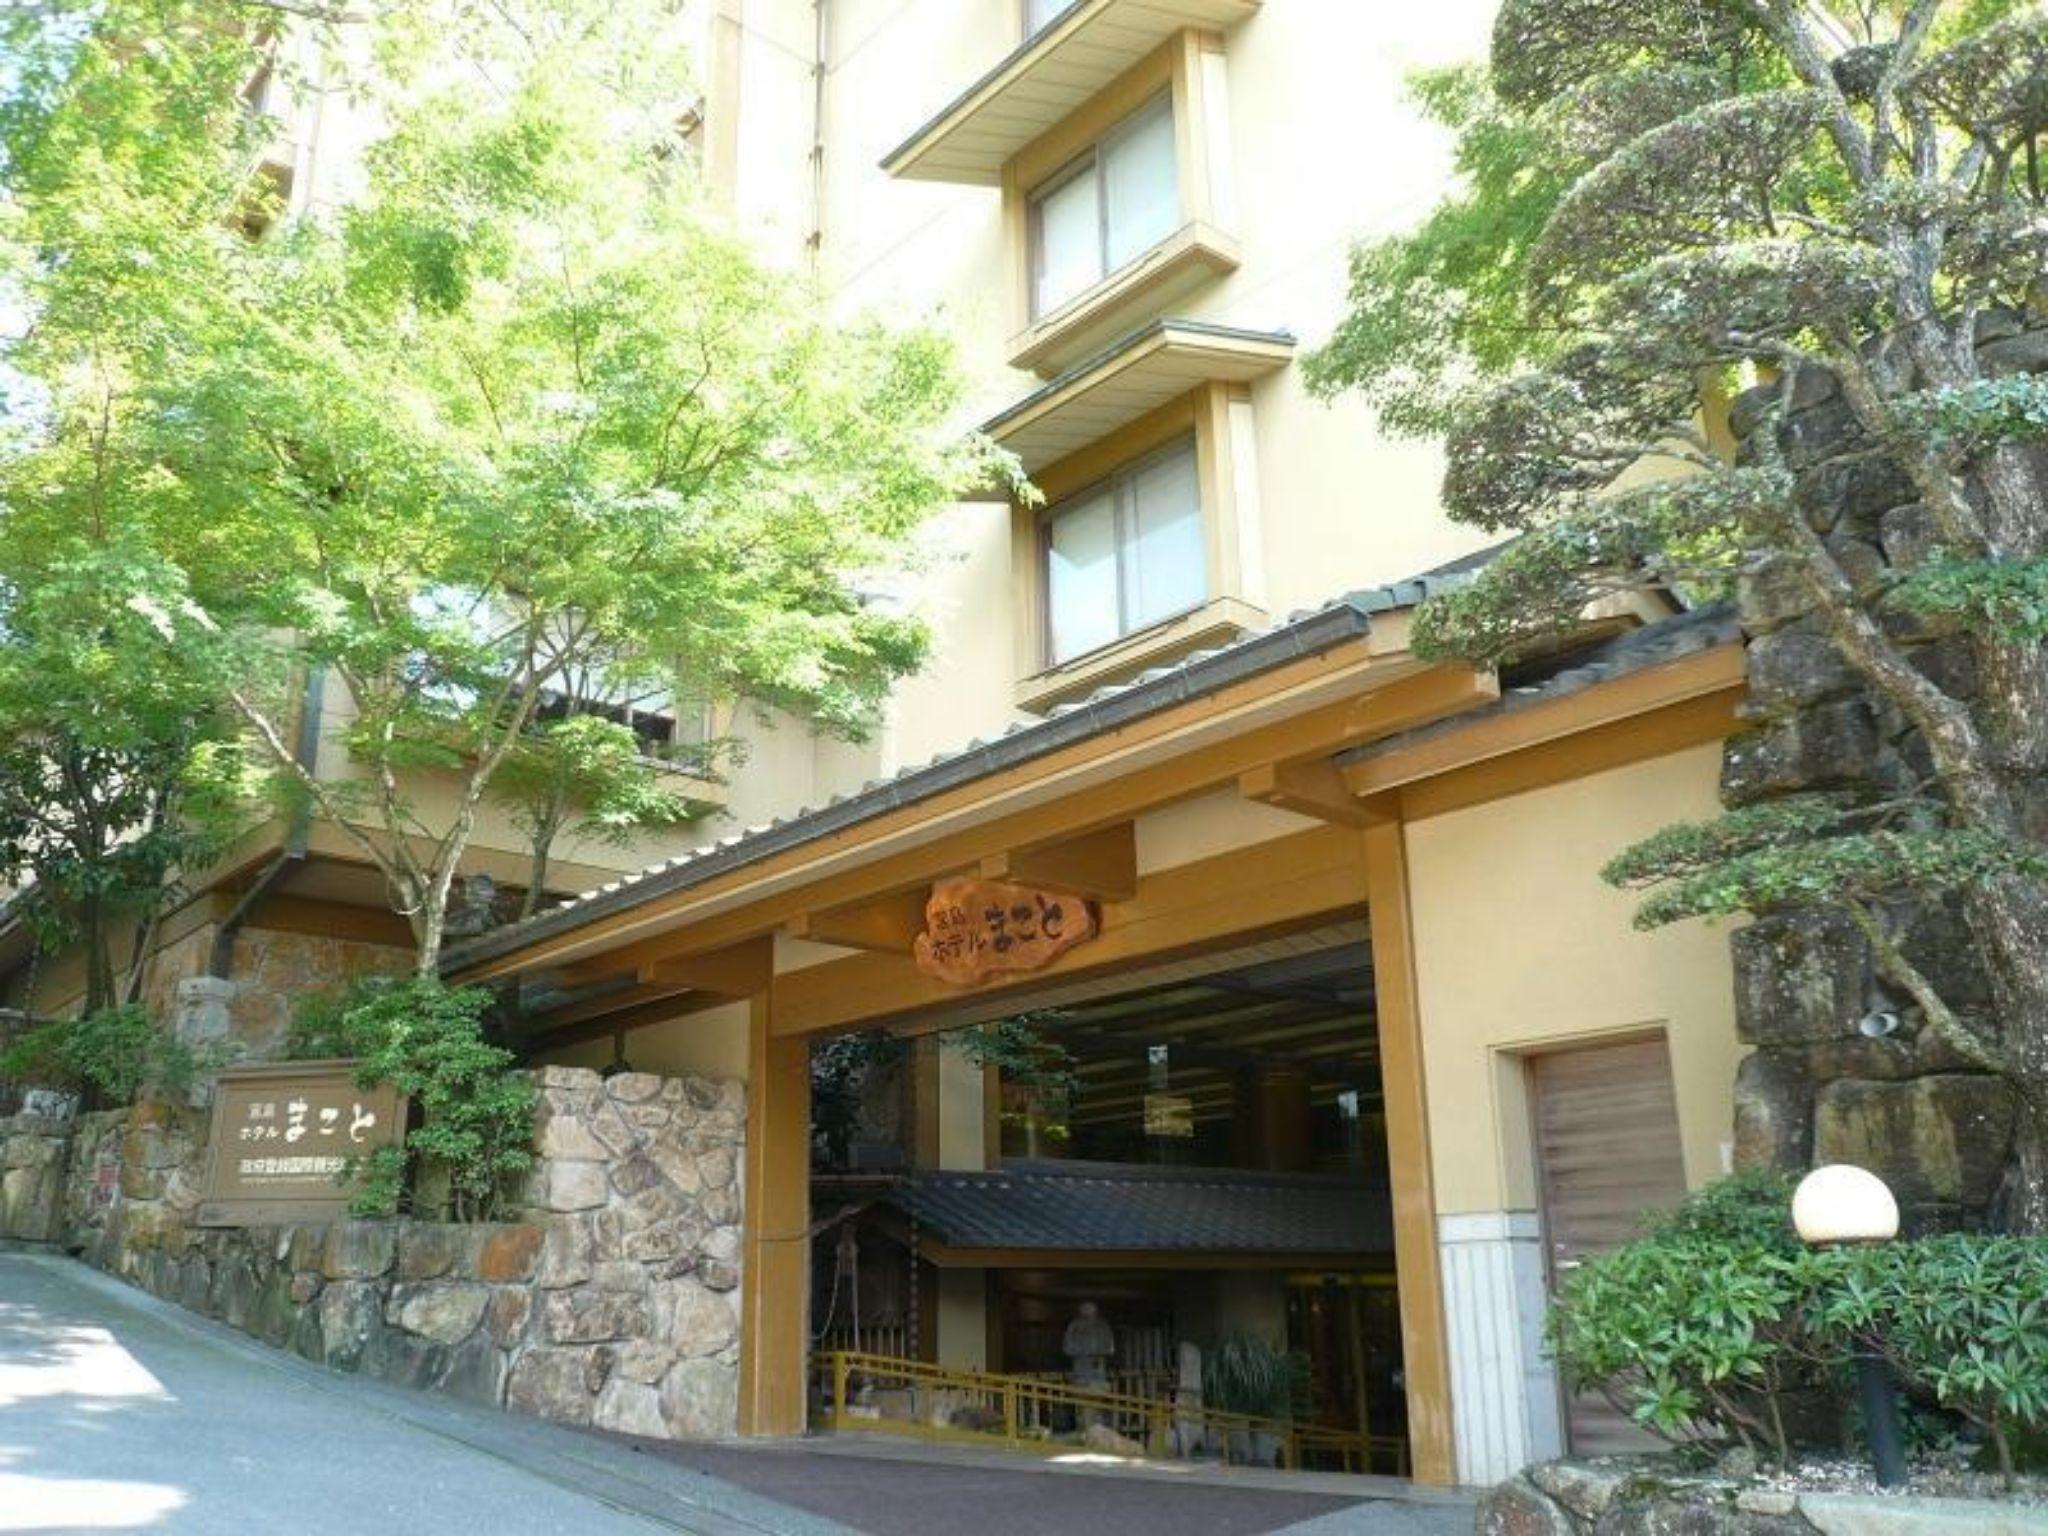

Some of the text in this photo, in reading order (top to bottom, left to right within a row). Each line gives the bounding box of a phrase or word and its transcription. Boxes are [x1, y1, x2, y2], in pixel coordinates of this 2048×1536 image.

[985, 893, 1064, 954] まこと
[932, 931, 987, 962] ホテル
[239, 1125, 280, 1141] ホテル
[284, 1096, 376, 1143] まこと
